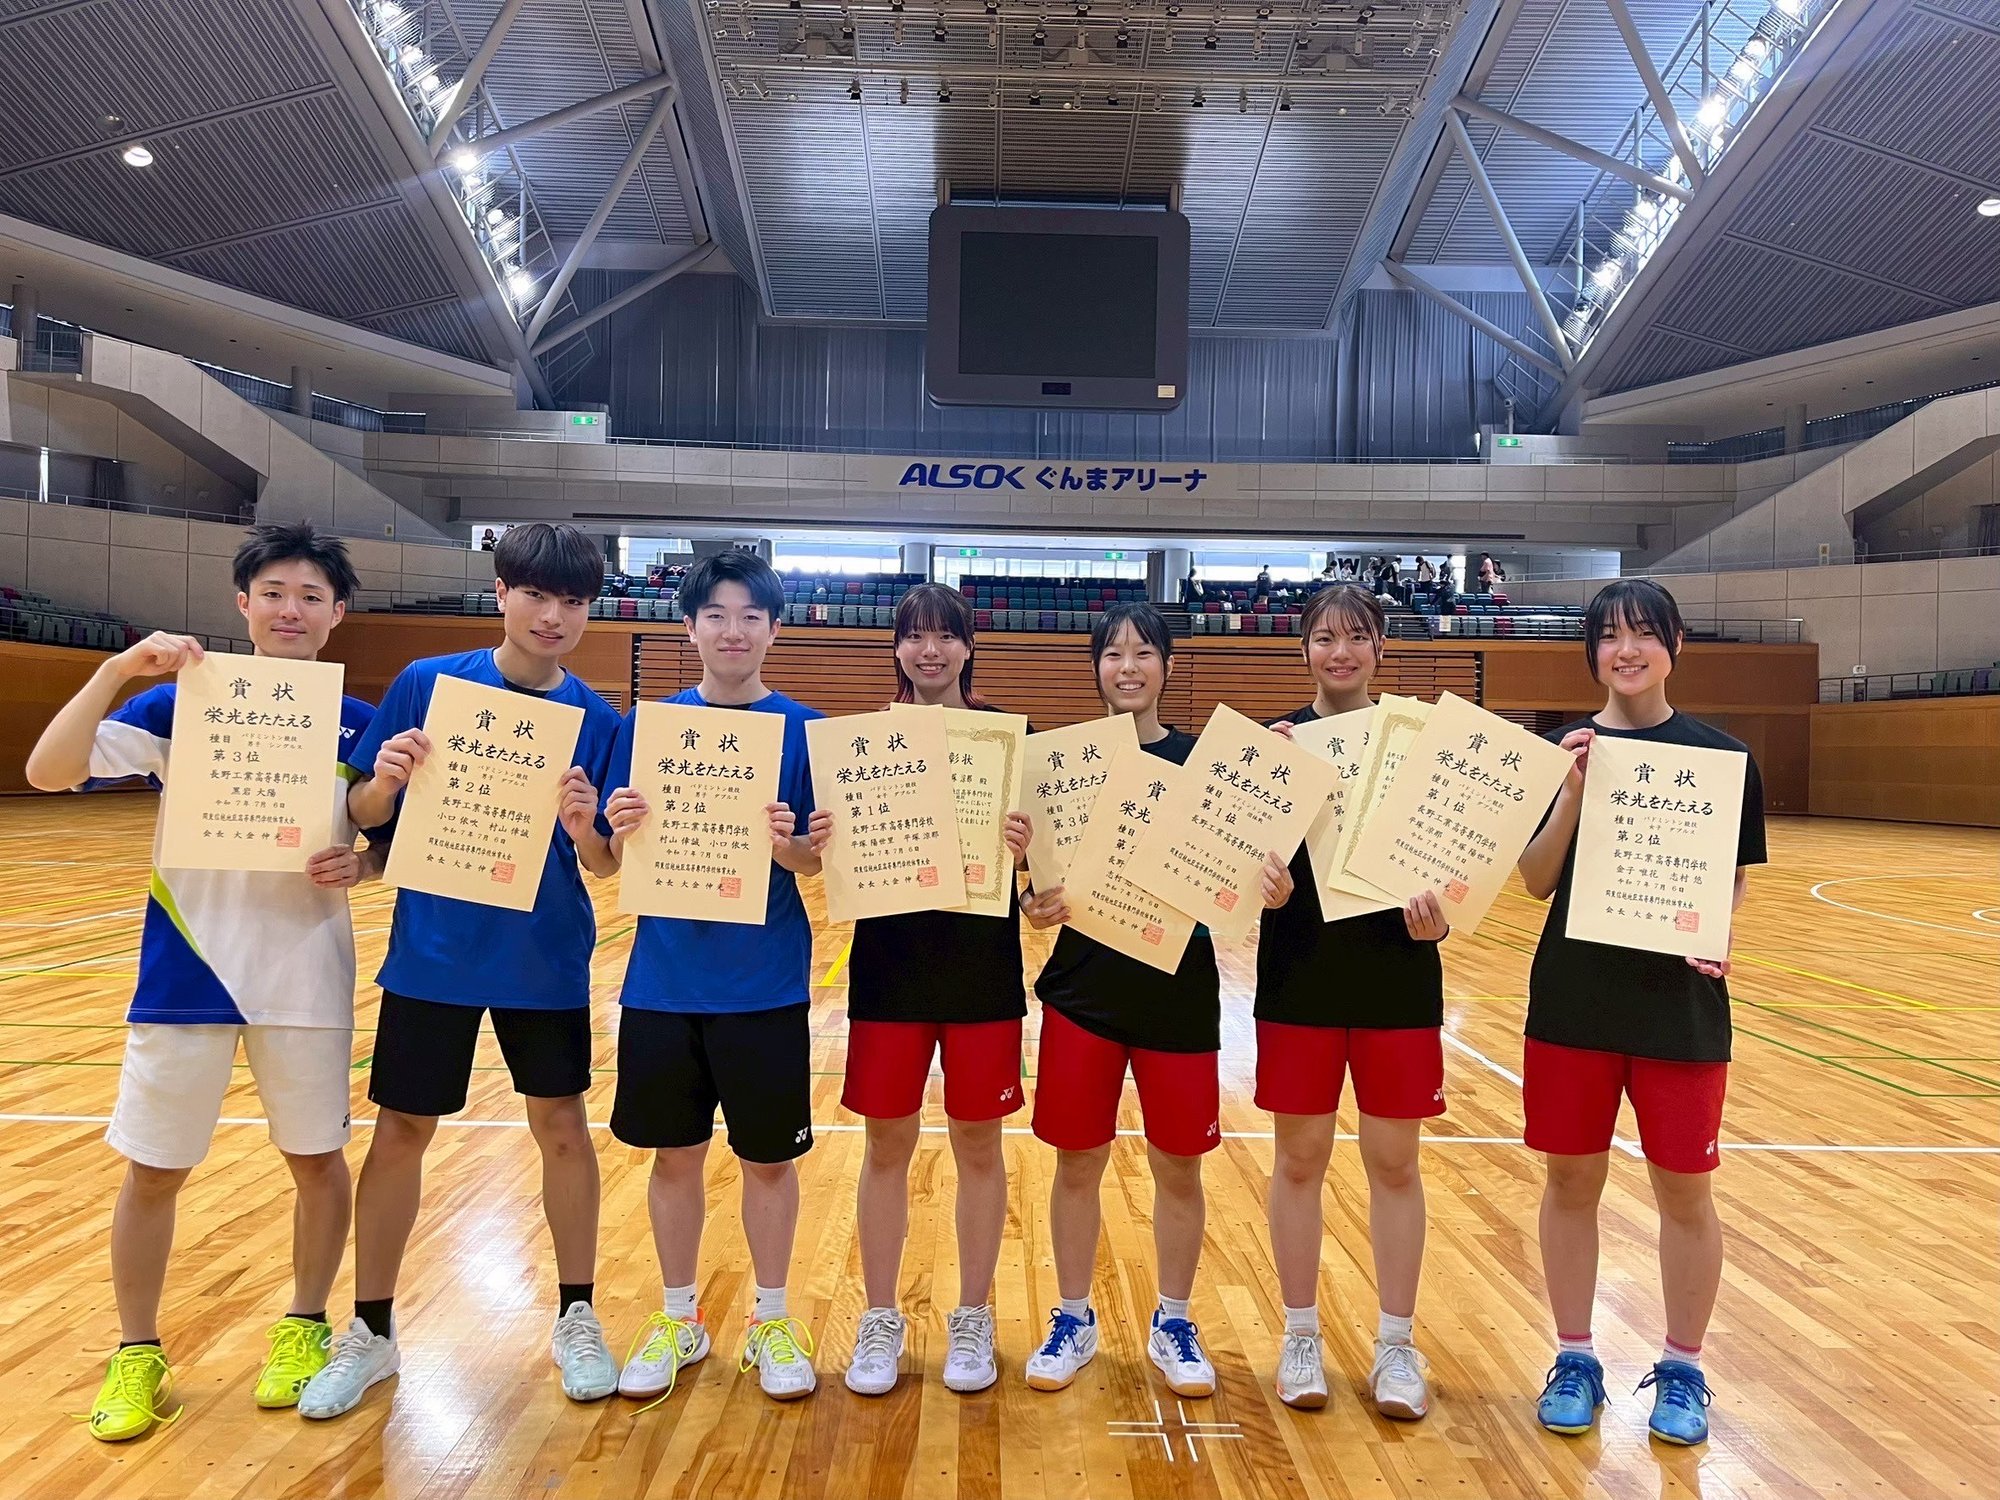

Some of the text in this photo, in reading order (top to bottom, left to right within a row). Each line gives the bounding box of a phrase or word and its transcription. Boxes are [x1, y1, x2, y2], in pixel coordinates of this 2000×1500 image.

[899, 463, 1207, 492] ALSOK ぐんまアリーナ
[229, 677, 295, 701] 賞状
[204, 707, 312, 728] 栄光をたたえる
[475, 709, 534, 739] 賞状
[209, 733, 231, 743] 種目
[680, 728, 739, 752] 賞状
[851, 732, 908, 756] 賞状
[213, 749, 260, 762] 第3位
[448, 735, 545, 768] 栄光をたたえる
[1047, 743, 1103, 772] 賞状
[1467, 733, 1522, 771] 賞状
[448, 761, 468, 773] 種目
[658, 758, 754, 779] 栄光をたたえる
[836, 759, 927, 783] 栄光をたたえる
[1239, 746, 1291, 784] 賞状
[1437, 750, 1524, 801] 栄光をたたえる
[1634, 763, 1696, 787] 賞状
[210, 769, 308, 784] 長野工業高等専門学校
[448, 777, 491, 795] 第2位
[1210, 761, 1292, 813] 栄光をたたえる
[1431, 773, 1450, 787] 種目
[662, 784, 681, 794] 種目
[845, 792, 863, 801] 種目
[1147, 780, 1167, 801] 賞
[1205, 784, 1223, 798] 種目
[1326, 791, 1344, 802] 種目
[442, 796, 531, 823] 長野工業高等専門学校
[665, 799, 707, 813] 第2位
[851, 802, 890, 818] 第1位
[1046, 804, 1064, 815] 種目
[1200, 798, 1237, 824] 第1位
[1426, 788, 1465, 813] 第1位
[1611, 790, 1713, 815] 栄光をたたえる
[1053, 813, 1089, 831] 第3位
[1120, 800, 1151, 823] 栄光
[1614, 814, 1634, 825] 種目
[662, 819, 749, 836] 長野工業高等専門学校
[852, 816, 934, 834] 長野工業高等専門学校
[1118, 823, 1136, 836] 種目
[1417, 804, 1497, 851] 長野工業高等専門学校
[1056, 834, 1081, 847] 長野工
[1191, 814, 1265, 861] 長野工業高等専門学校
[1617, 830, 1661, 845] 第2位
[1108, 855, 1125, 867] 長野
[1614, 849, 1707, 870] 長野工業高等専門学校
